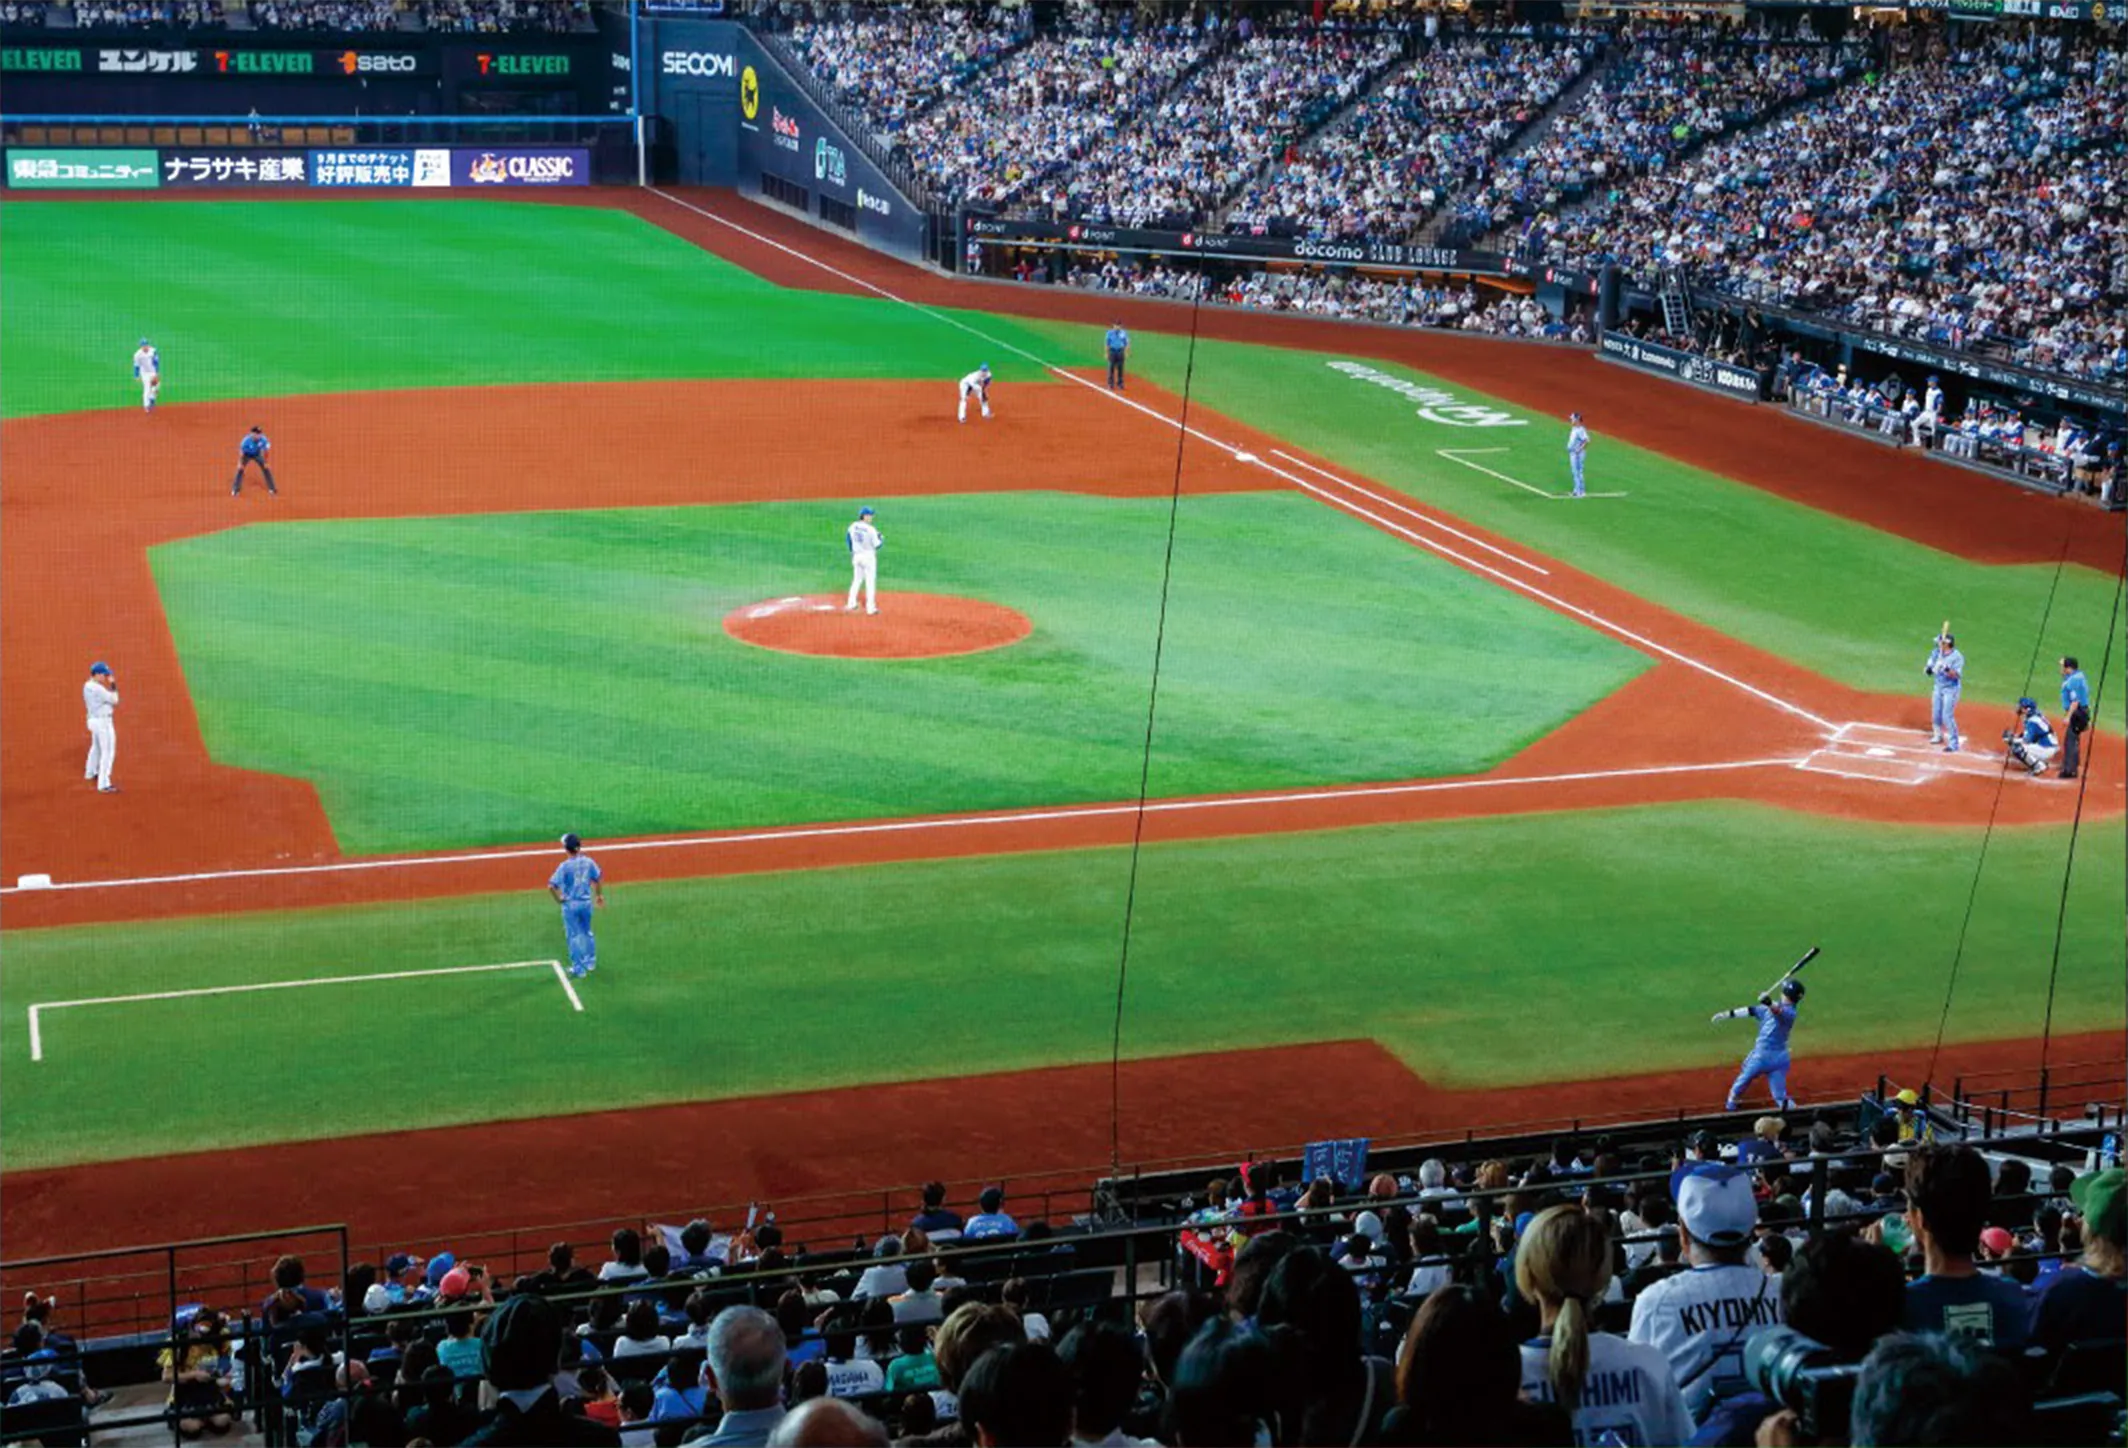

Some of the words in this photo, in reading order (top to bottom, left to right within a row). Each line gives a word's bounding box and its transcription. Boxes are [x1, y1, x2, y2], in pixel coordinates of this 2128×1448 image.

[99, 50, 198, 72] ユンケル
[357, 53, 417, 72] sato
[662, 51, 734, 77] SECOM
[165, 157, 305, 182] ナラサキ産業
[317, 165, 409, 184] 好評販売中
[508, 156, 574, 178] CLASSIC
[1294, 240, 1364, 260] docomo
